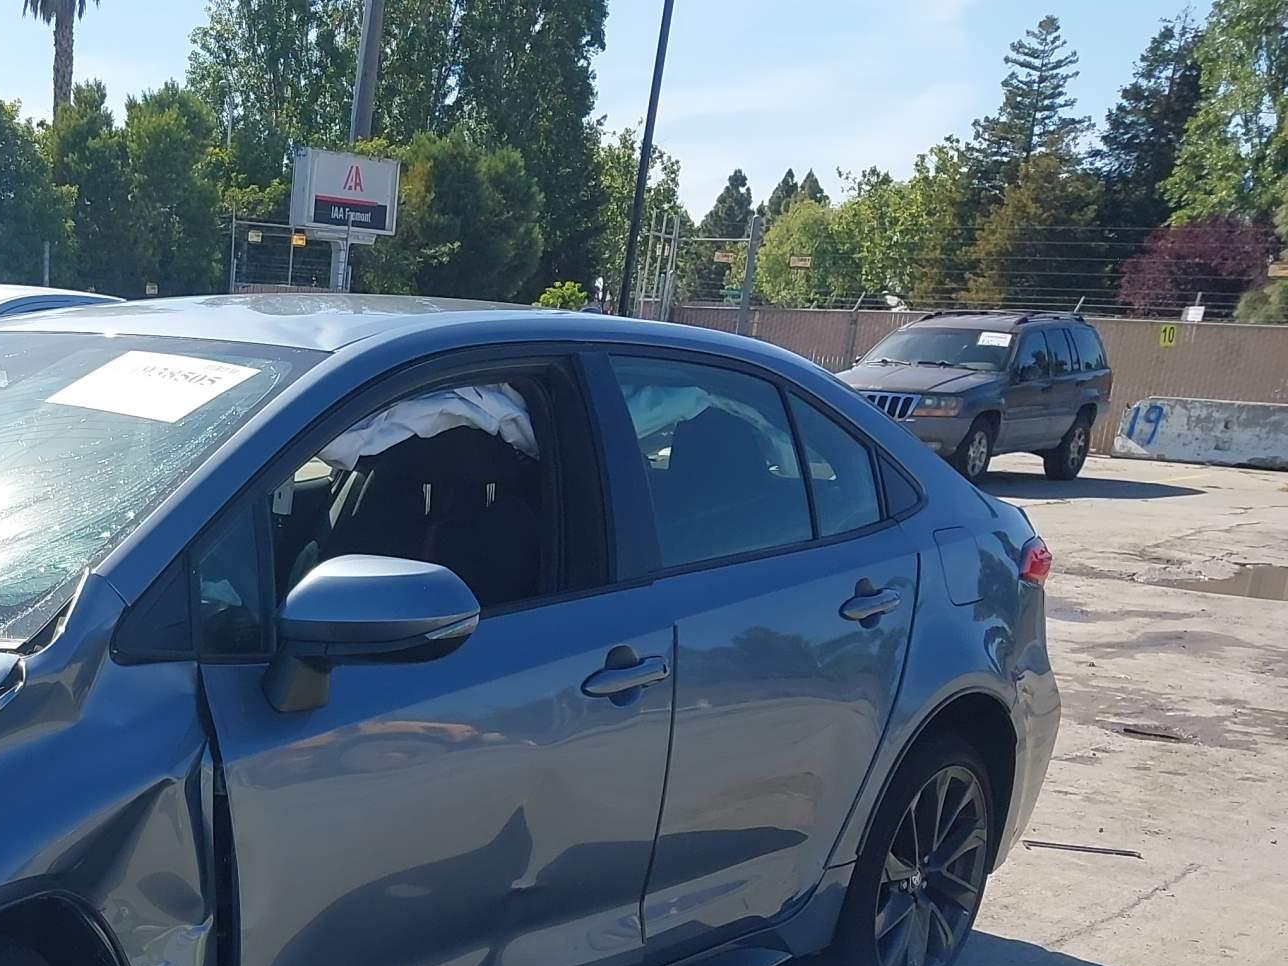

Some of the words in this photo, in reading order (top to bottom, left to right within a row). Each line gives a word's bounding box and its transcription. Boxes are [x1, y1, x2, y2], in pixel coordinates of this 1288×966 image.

[331, 205, 344, 220] IAA
[1161, 326, 1175, 343] 10
[1126, 405, 1164, 445] 19
